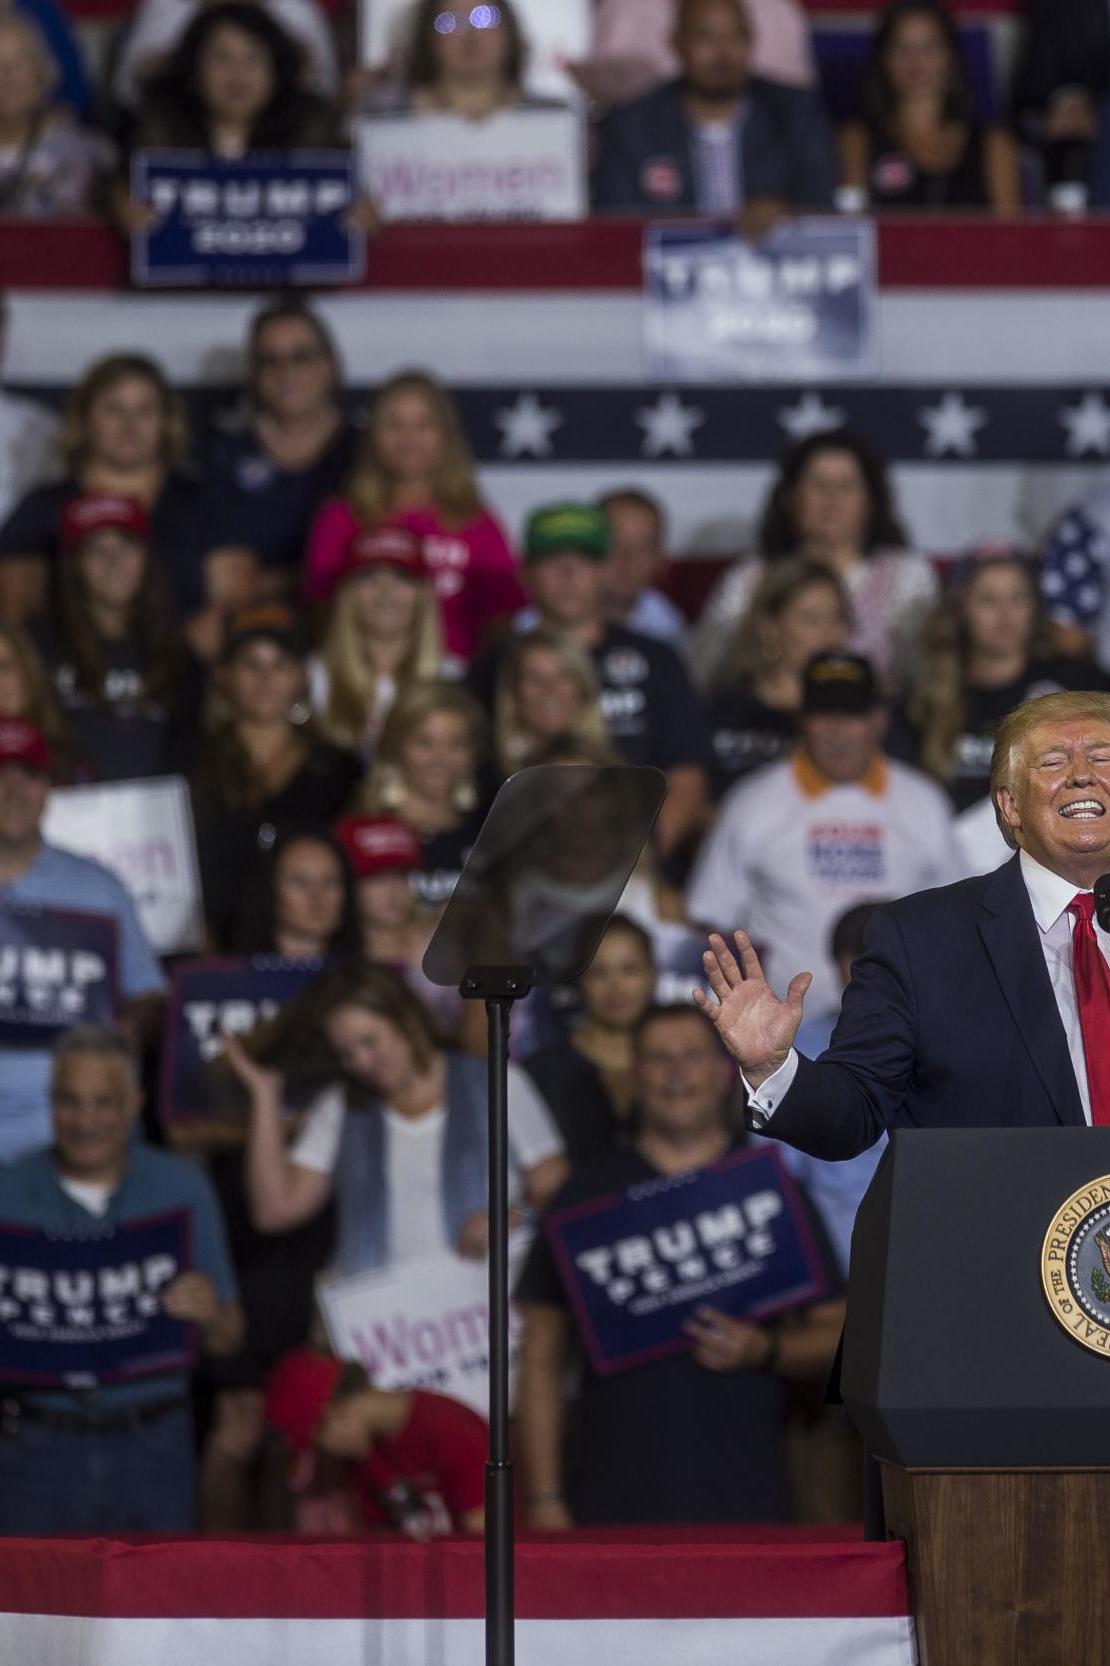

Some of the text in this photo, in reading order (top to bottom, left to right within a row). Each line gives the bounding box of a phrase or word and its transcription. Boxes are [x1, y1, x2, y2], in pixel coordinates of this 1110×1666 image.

[151, 178, 347, 216] TRUMP
[662, 254, 860, 297] TRUMP
[575, 1190, 782, 1286] TRUMP
[1051, 1270, 1065, 1294] THE
[1059, 1298, 1073, 1314] OF
